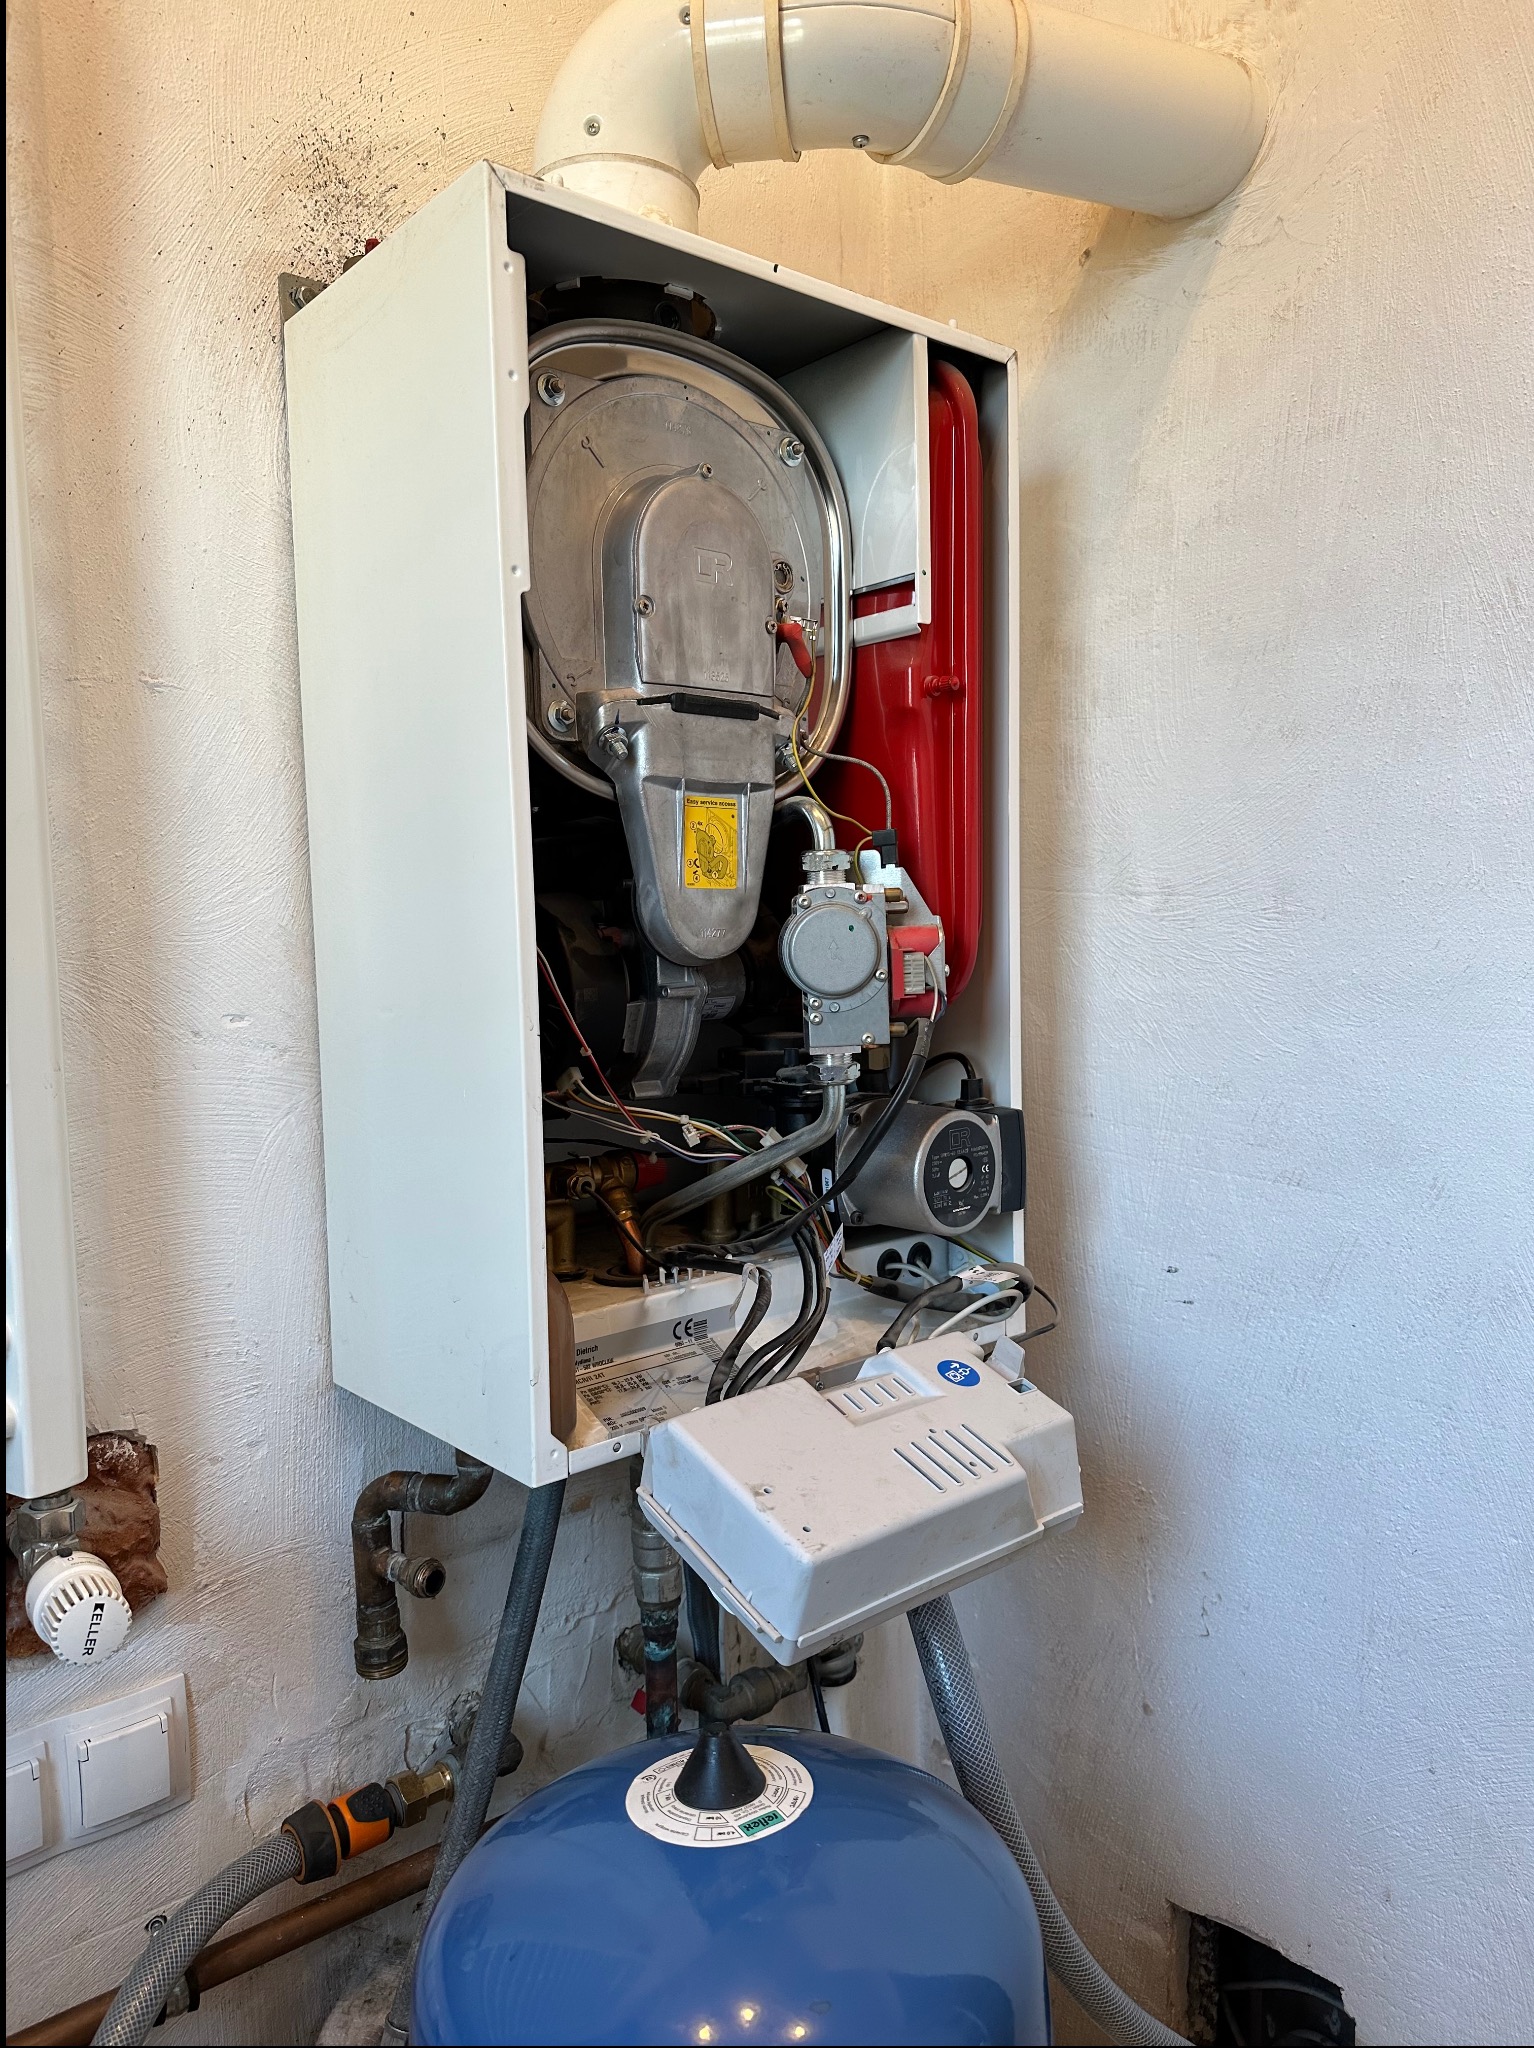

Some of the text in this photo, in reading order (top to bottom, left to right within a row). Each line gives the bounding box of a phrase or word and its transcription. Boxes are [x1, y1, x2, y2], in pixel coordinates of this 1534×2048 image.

[576, 1345, 599, 1356] Dietrich
[82, 1603, 105, 1656] KELLER
[918, 1630, 934, 1669] HOSE
[743, 1812, 780, 1832] reflex
